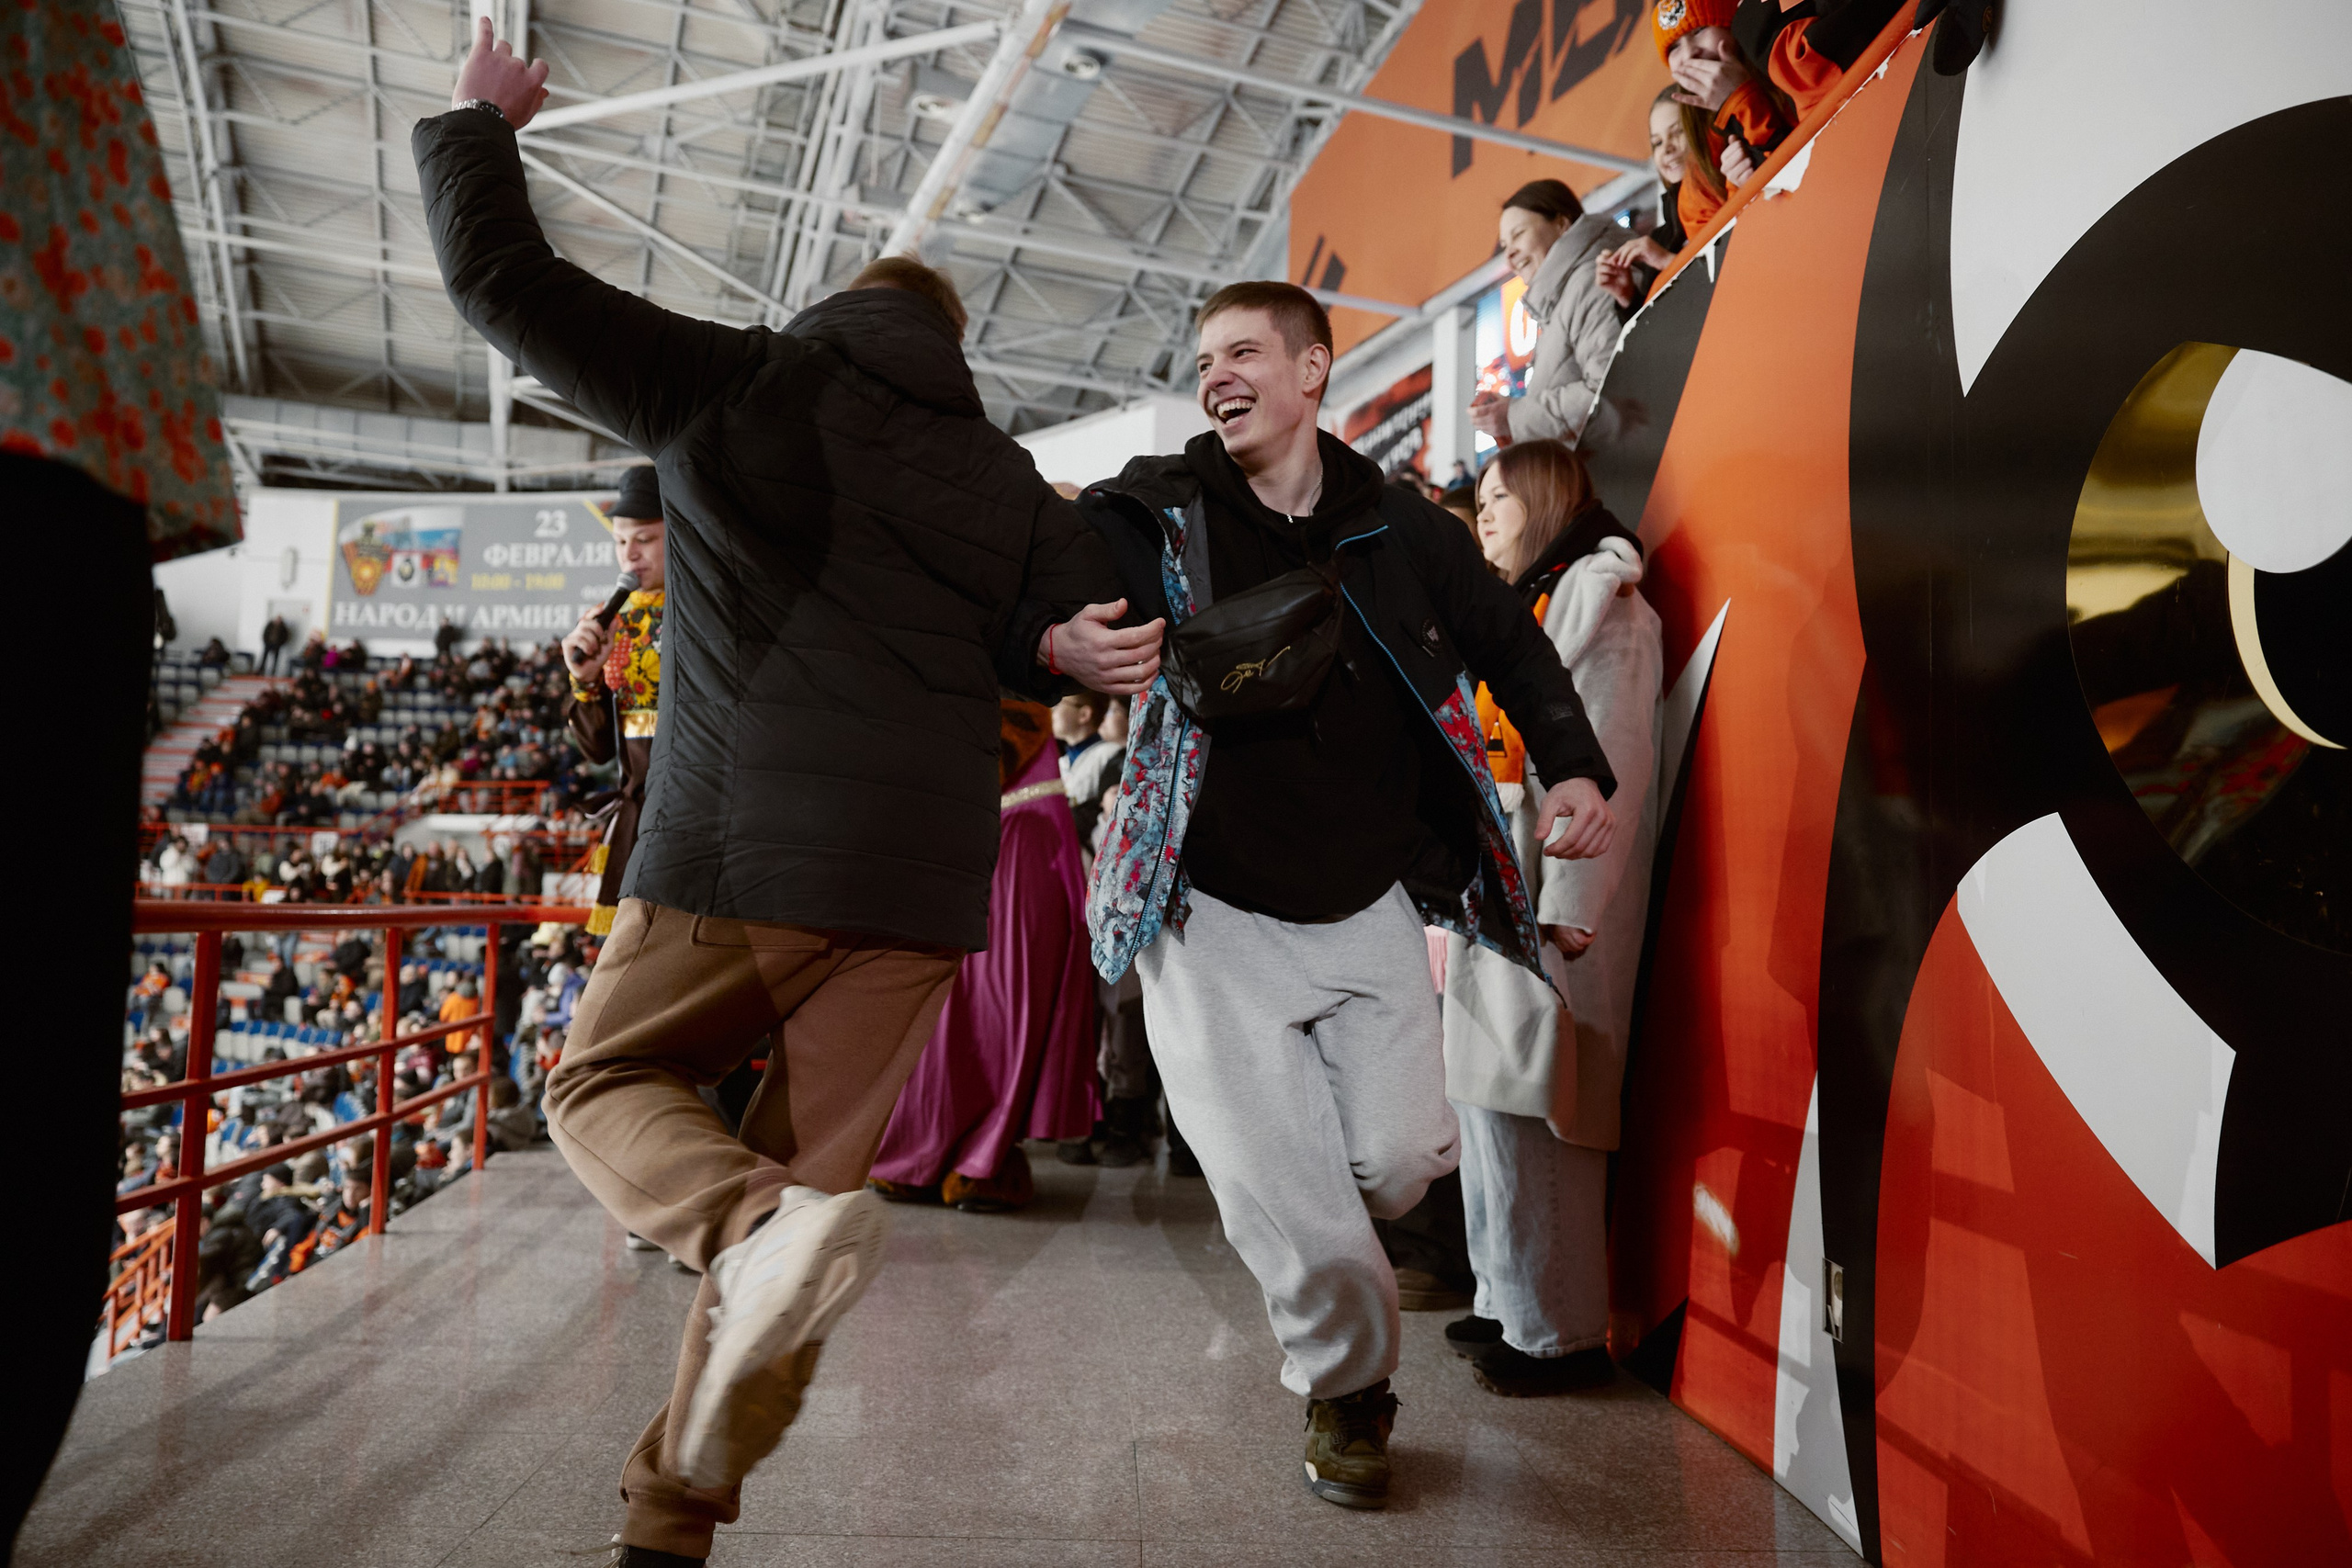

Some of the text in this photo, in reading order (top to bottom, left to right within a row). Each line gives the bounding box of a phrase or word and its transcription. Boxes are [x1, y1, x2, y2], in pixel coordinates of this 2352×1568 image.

[536, 510, 567, 538] 23
[483, 542, 614, 568] ФЕВРАЛЯ
[334, 602, 437, 631] НАРОД
[445, 604, 466, 627] И
[471, 604, 571, 629] АРМИЯ
